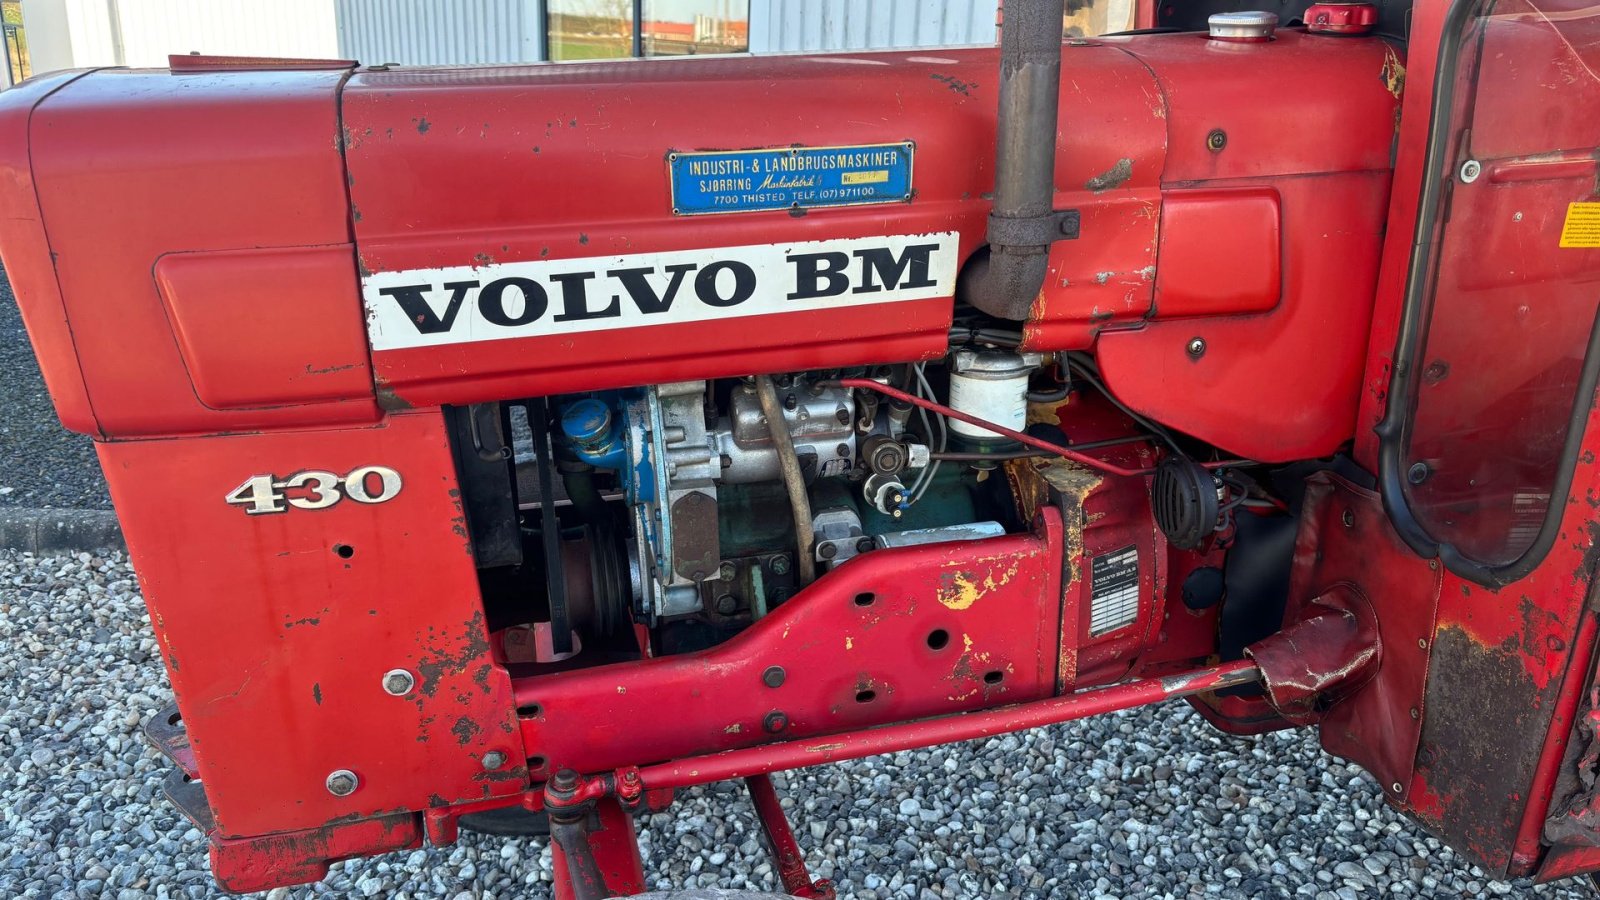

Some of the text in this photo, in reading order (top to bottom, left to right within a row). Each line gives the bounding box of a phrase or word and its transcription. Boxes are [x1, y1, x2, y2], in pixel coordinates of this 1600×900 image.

[764, 151, 898, 173] LANDBRUGSMASKINER
[700, 178, 752, 193] SJØRRING
[714, 195, 739, 204] 7700
[742, 192, 786, 203] THISTED
[380, 243, 940, 335] VOLVO BM
[225, 466, 403, 514] 430
